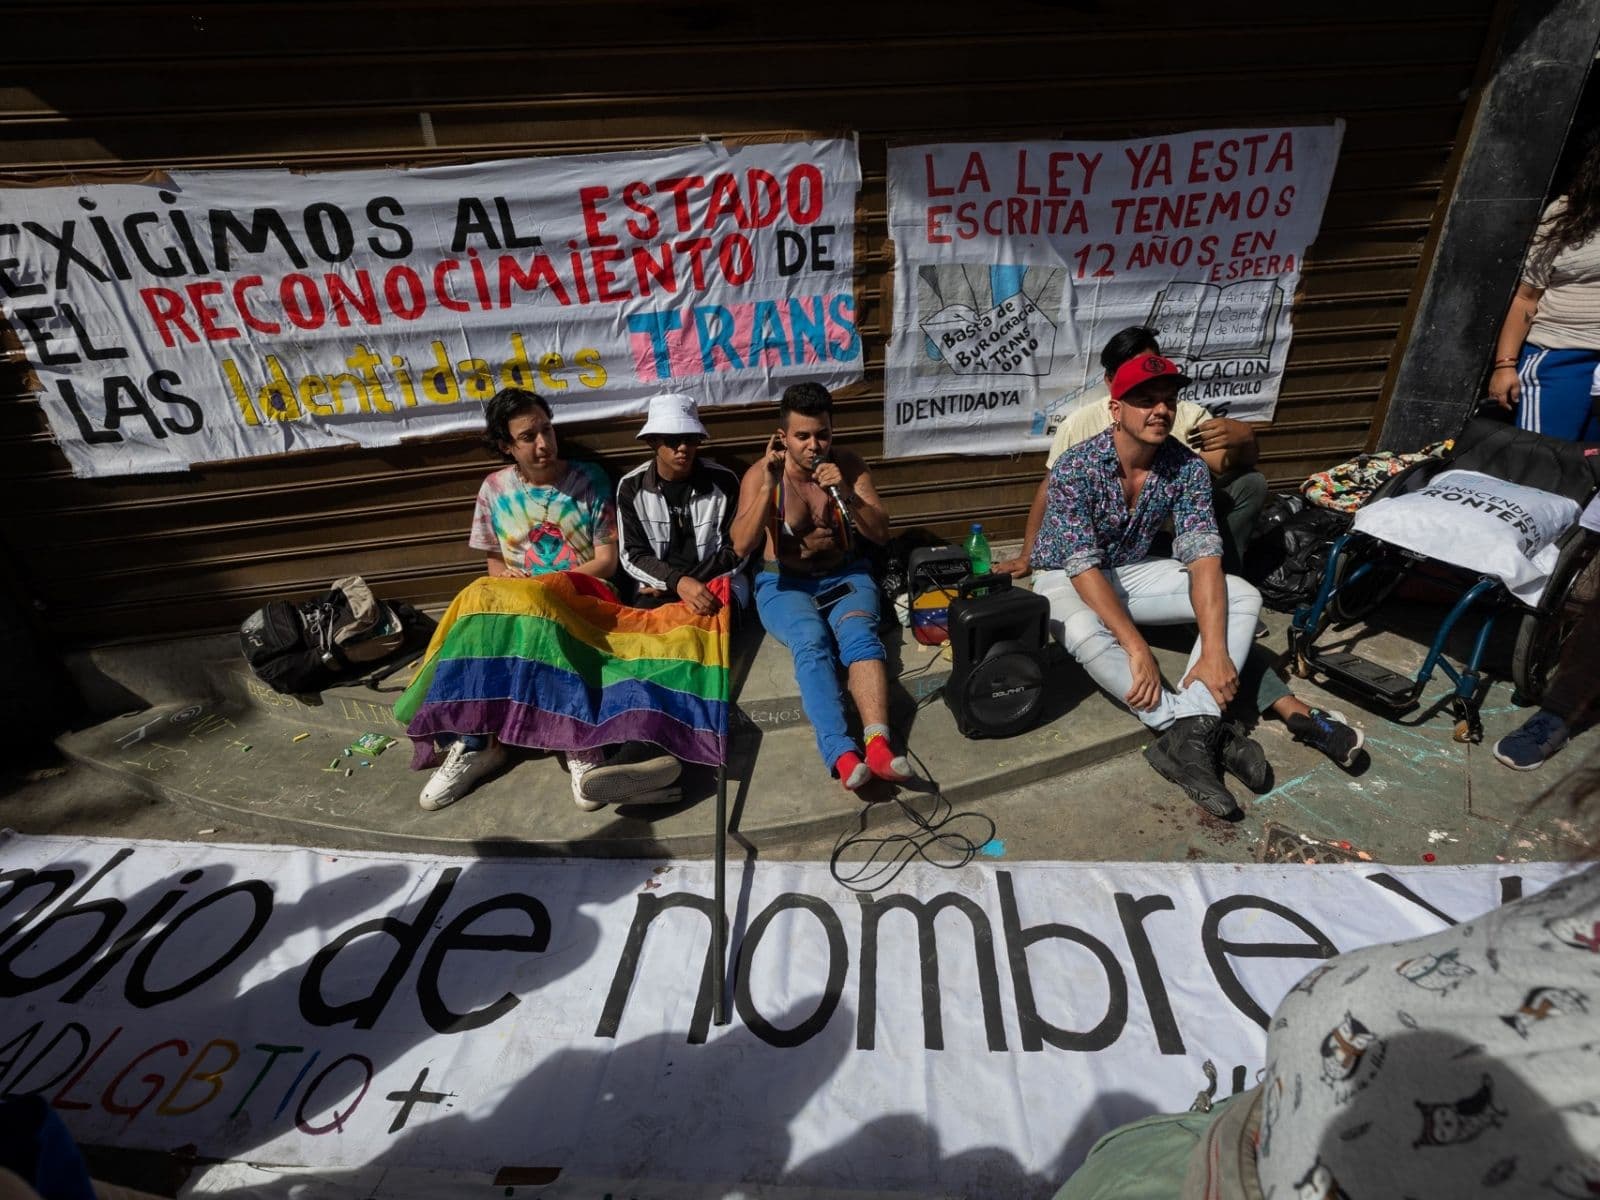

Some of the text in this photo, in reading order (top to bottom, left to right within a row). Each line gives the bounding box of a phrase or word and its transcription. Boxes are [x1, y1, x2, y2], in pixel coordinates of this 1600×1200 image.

[924, 131, 1295, 197] LA LEY YA ESTA
[451, 196, 543, 252] AL
[579, 163, 824, 247] ESTADO
[927, 184, 1296, 244] ESCRITA TENEMOS
[1072, 228, 1278, 280] 12 AÑOS EN
[1210, 253, 1295, 282] ESPERA
[14, 303, 128, 365] EL
[776, 225, 835, 277] DE
[941, 301, 1015, 349] Basta de
[975, 326, 1031, 371] Y TRANS
[56, 369, 204, 444] LAS
[626, 293, 860, 381] TRANS
[1001, 338, 1039, 372] ODIO
[1203, 380, 1262, 399] ARTICULO
[299, 867, 552, 1034] de
[594, 870, 1340, 1055] nombre
